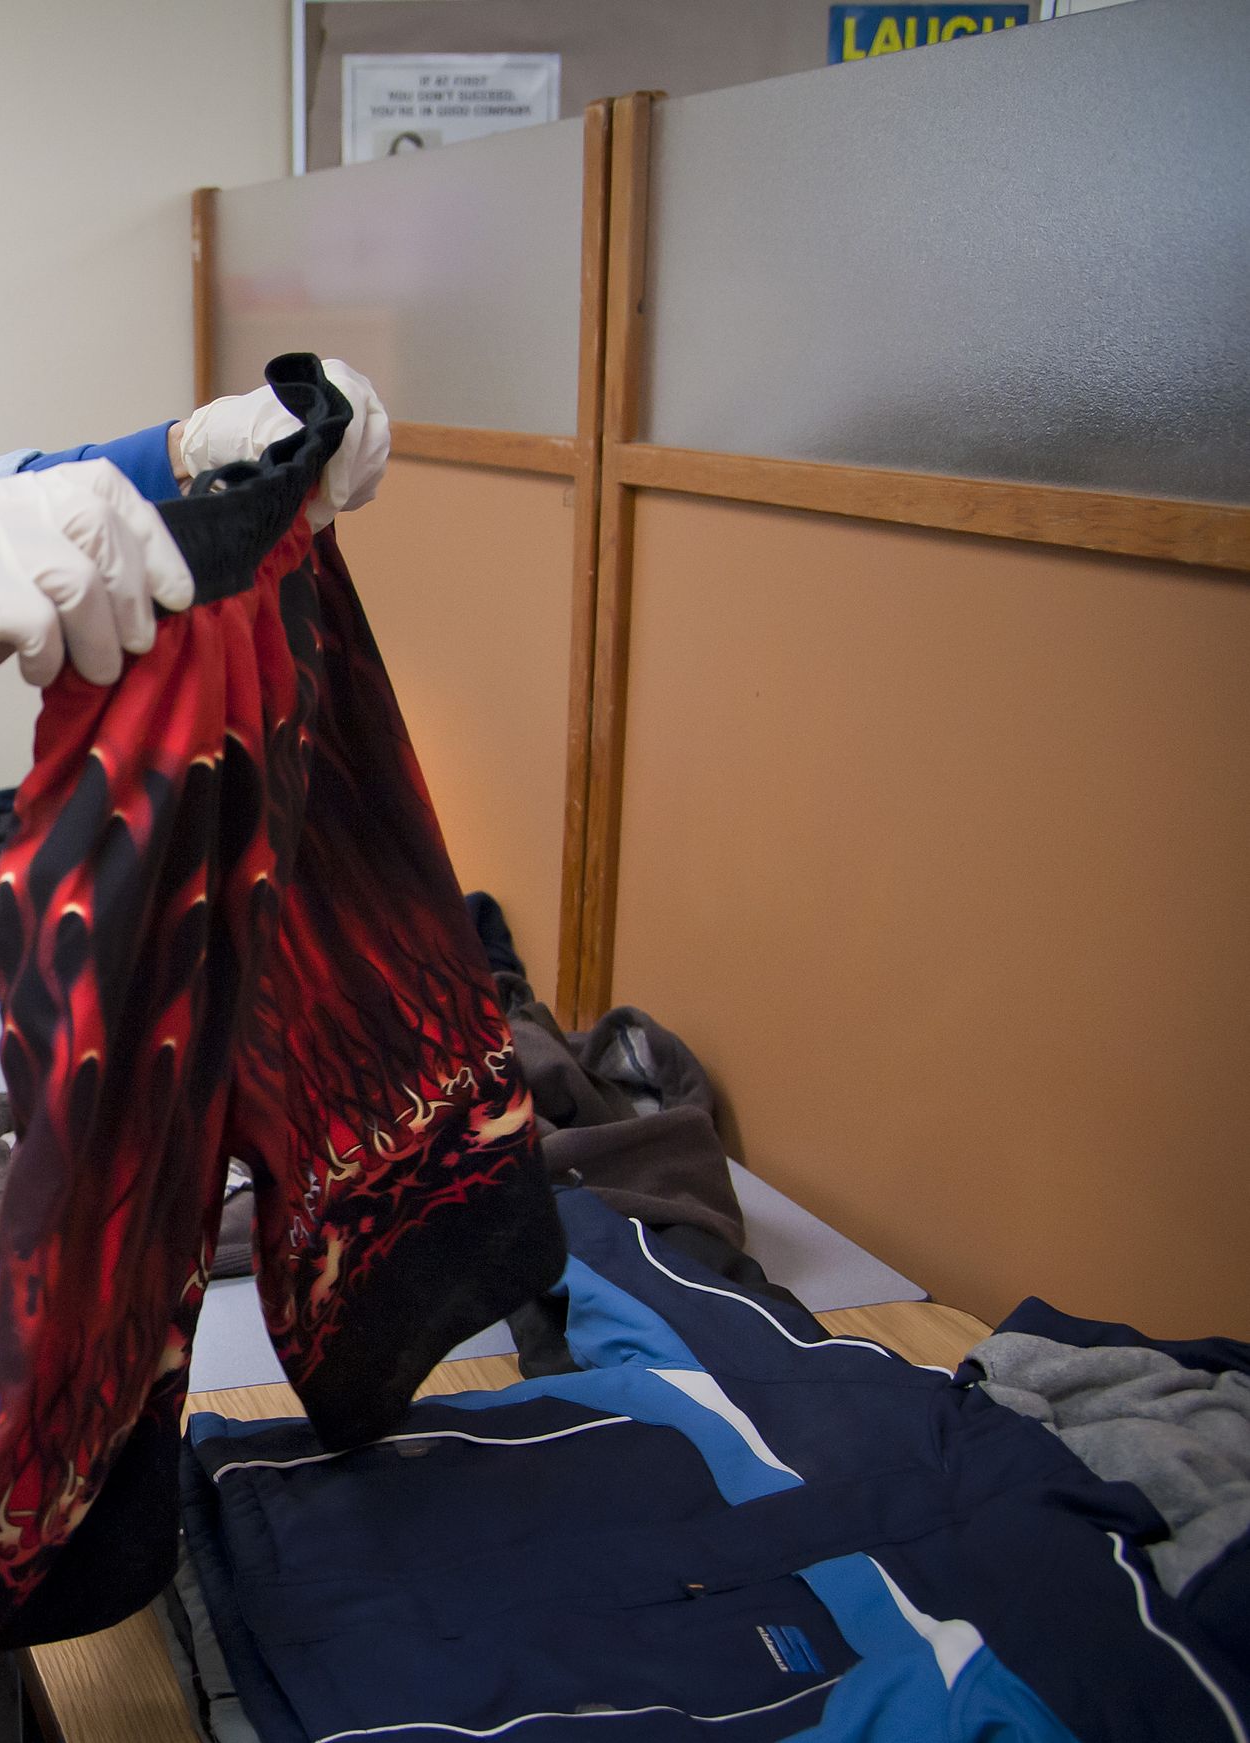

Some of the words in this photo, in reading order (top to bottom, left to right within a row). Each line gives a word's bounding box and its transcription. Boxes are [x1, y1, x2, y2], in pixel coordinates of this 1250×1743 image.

[453, 76, 488, 87] FIRST
[388, 91, 413, 102] YOU
[417, 90, 454, 102] DON'T
[370, 105, 414, 117] YOU'RE
[419, 105, 432, 116] IN
[436, 105, 470, 117] GOOD
